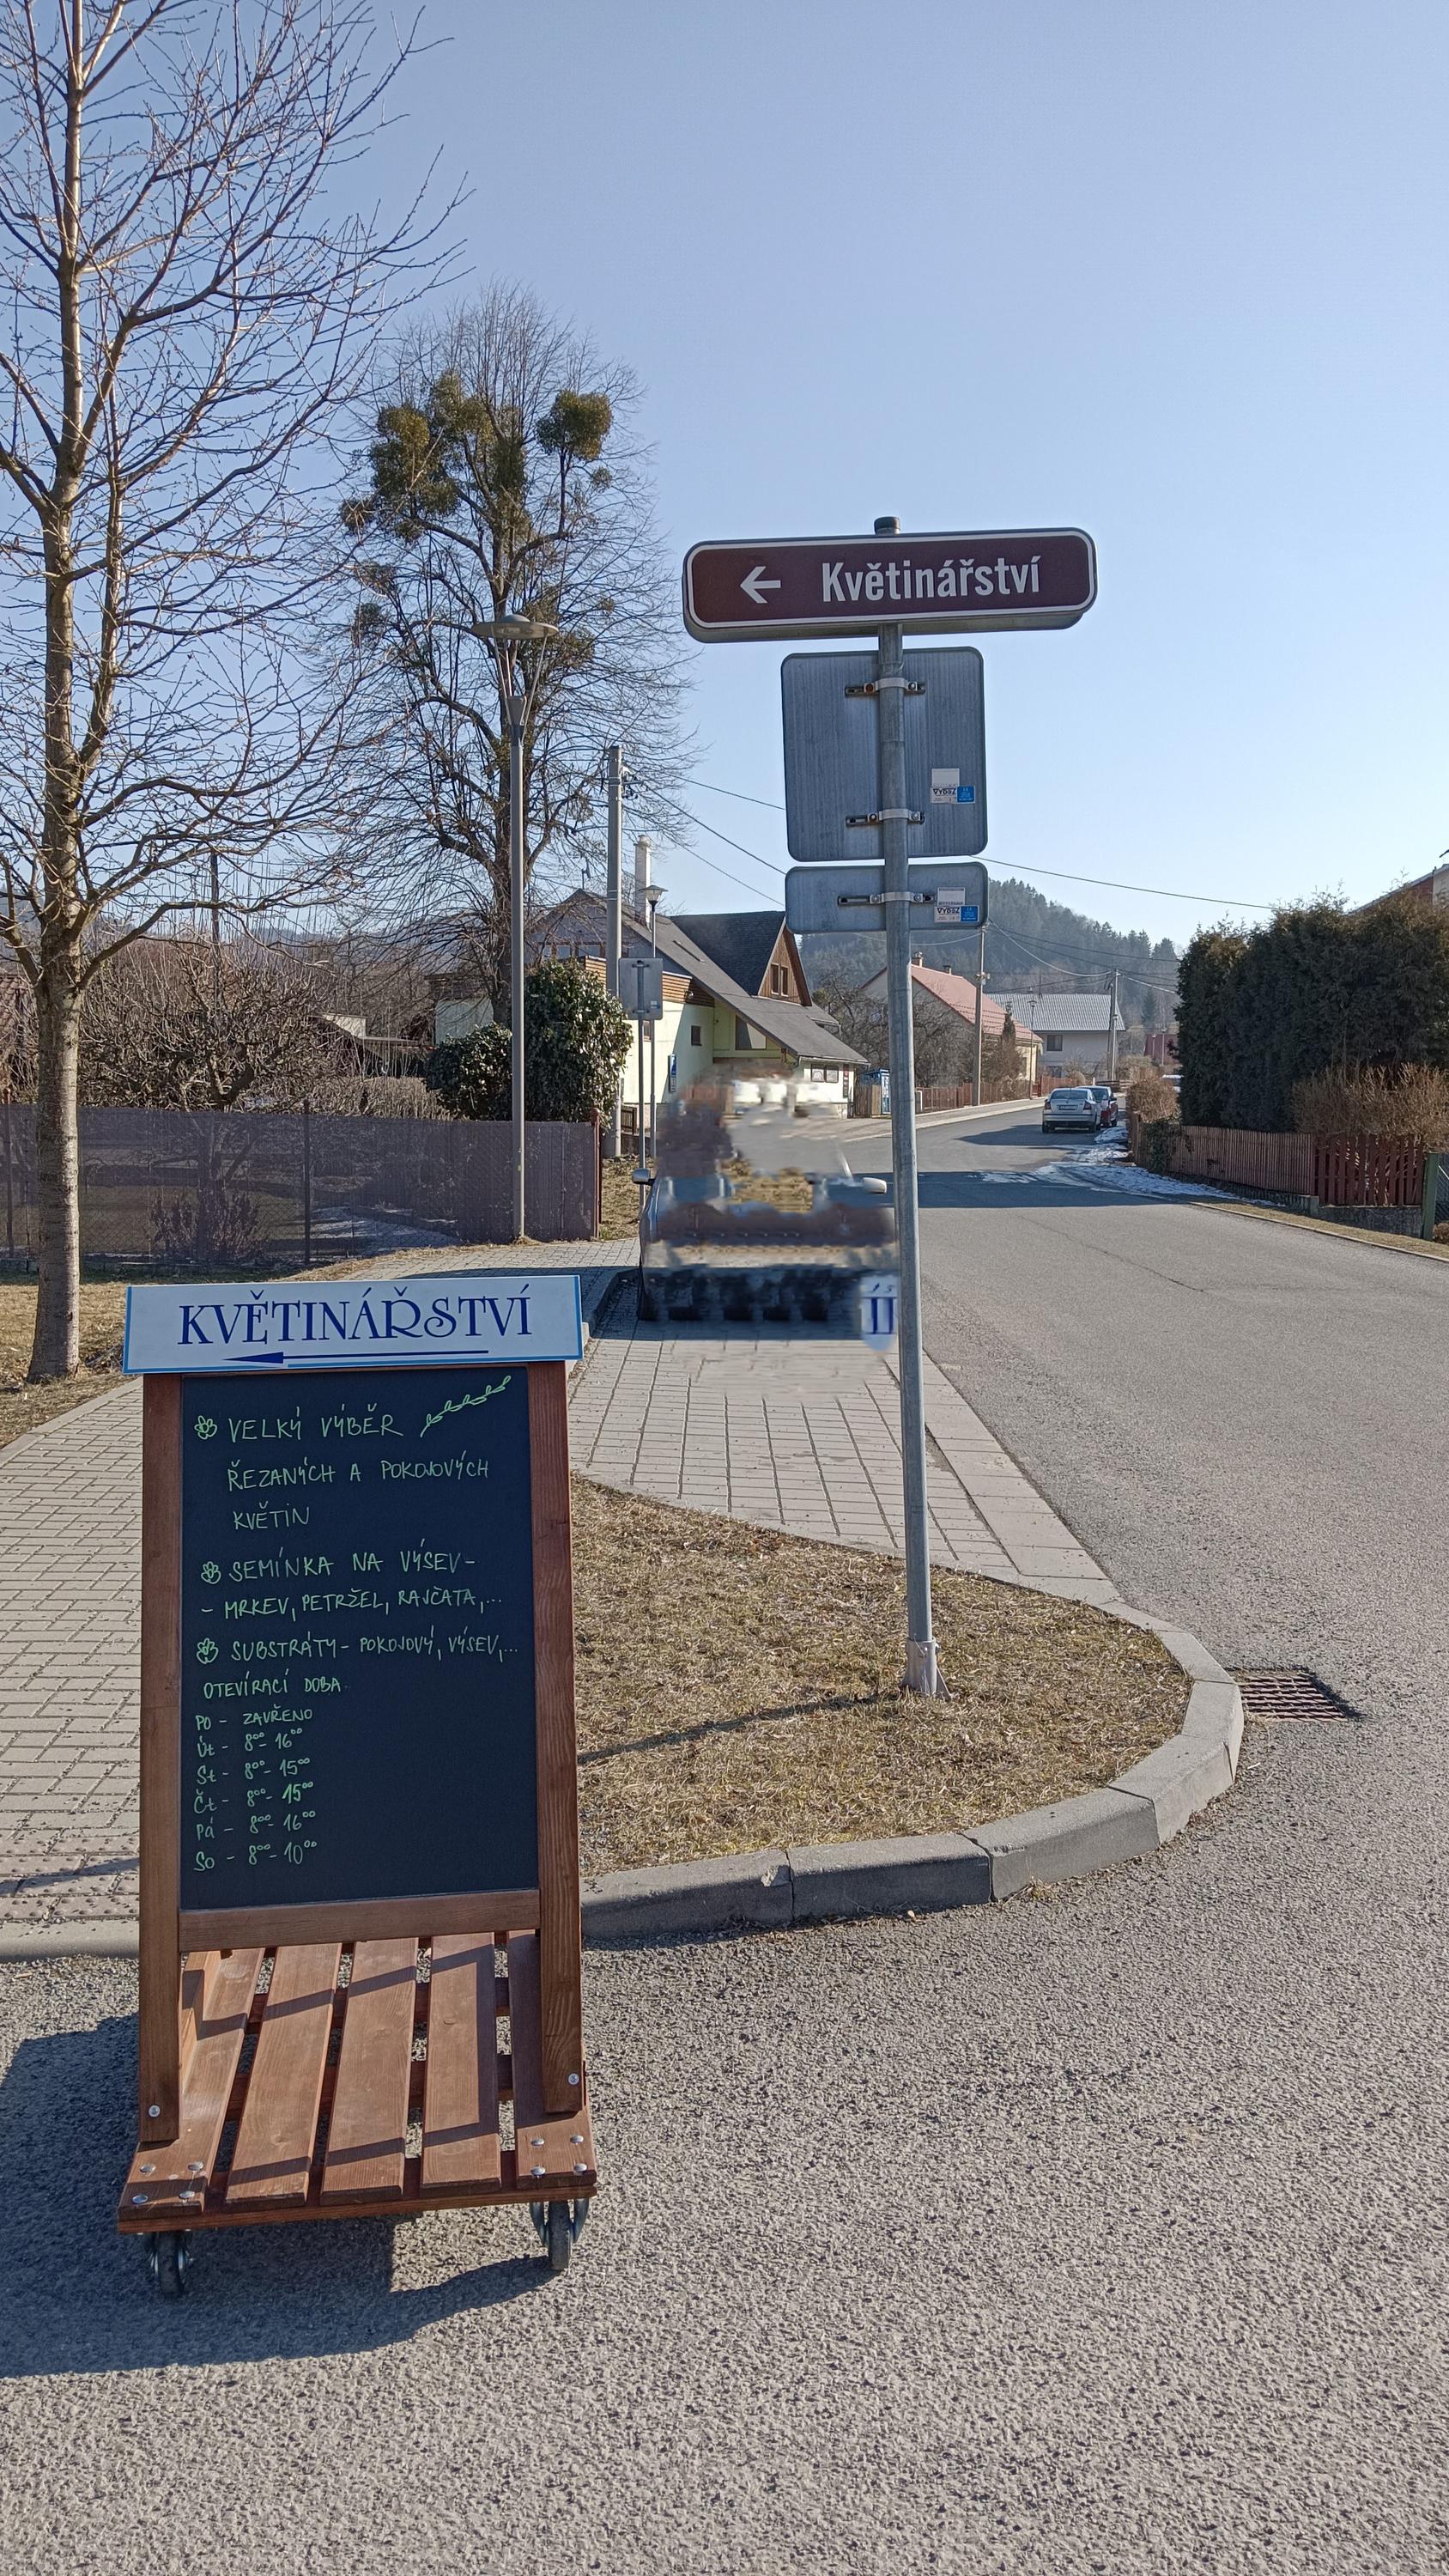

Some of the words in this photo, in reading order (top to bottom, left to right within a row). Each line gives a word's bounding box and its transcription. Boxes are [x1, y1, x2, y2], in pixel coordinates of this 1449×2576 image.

[822, 556, 1041, 602] Květinářství
[177, 1283, 532, 1345] KVĚTINÁŘSTVÍ
[228, 1406, 301, 1443] VELKÝ
[321, 1402, 403, 1437] VÝBĚR
[227, 1456, 336, 1492] ŘEZANÝCH
[349, 1463, 361, 1482] A
[380, 1450, 488, 1479] POKOJOVÝCH
[233, 1500, 310, 1530] KVĚTIN
[228, 1546, 334, 1583] SEMÍNKA
[352, 1552, 384, 1572] NA
[224, 1597, 296, 1621] MRKEV,
[301, 1588, 389, 1614] PETRŽEL,
[203, 1668, 289, 1699] OTEVÍRACÍ
[304, 1676, 342, 1693] DOBA
[242, 1704, 312, 1726] ZAVŘENO
